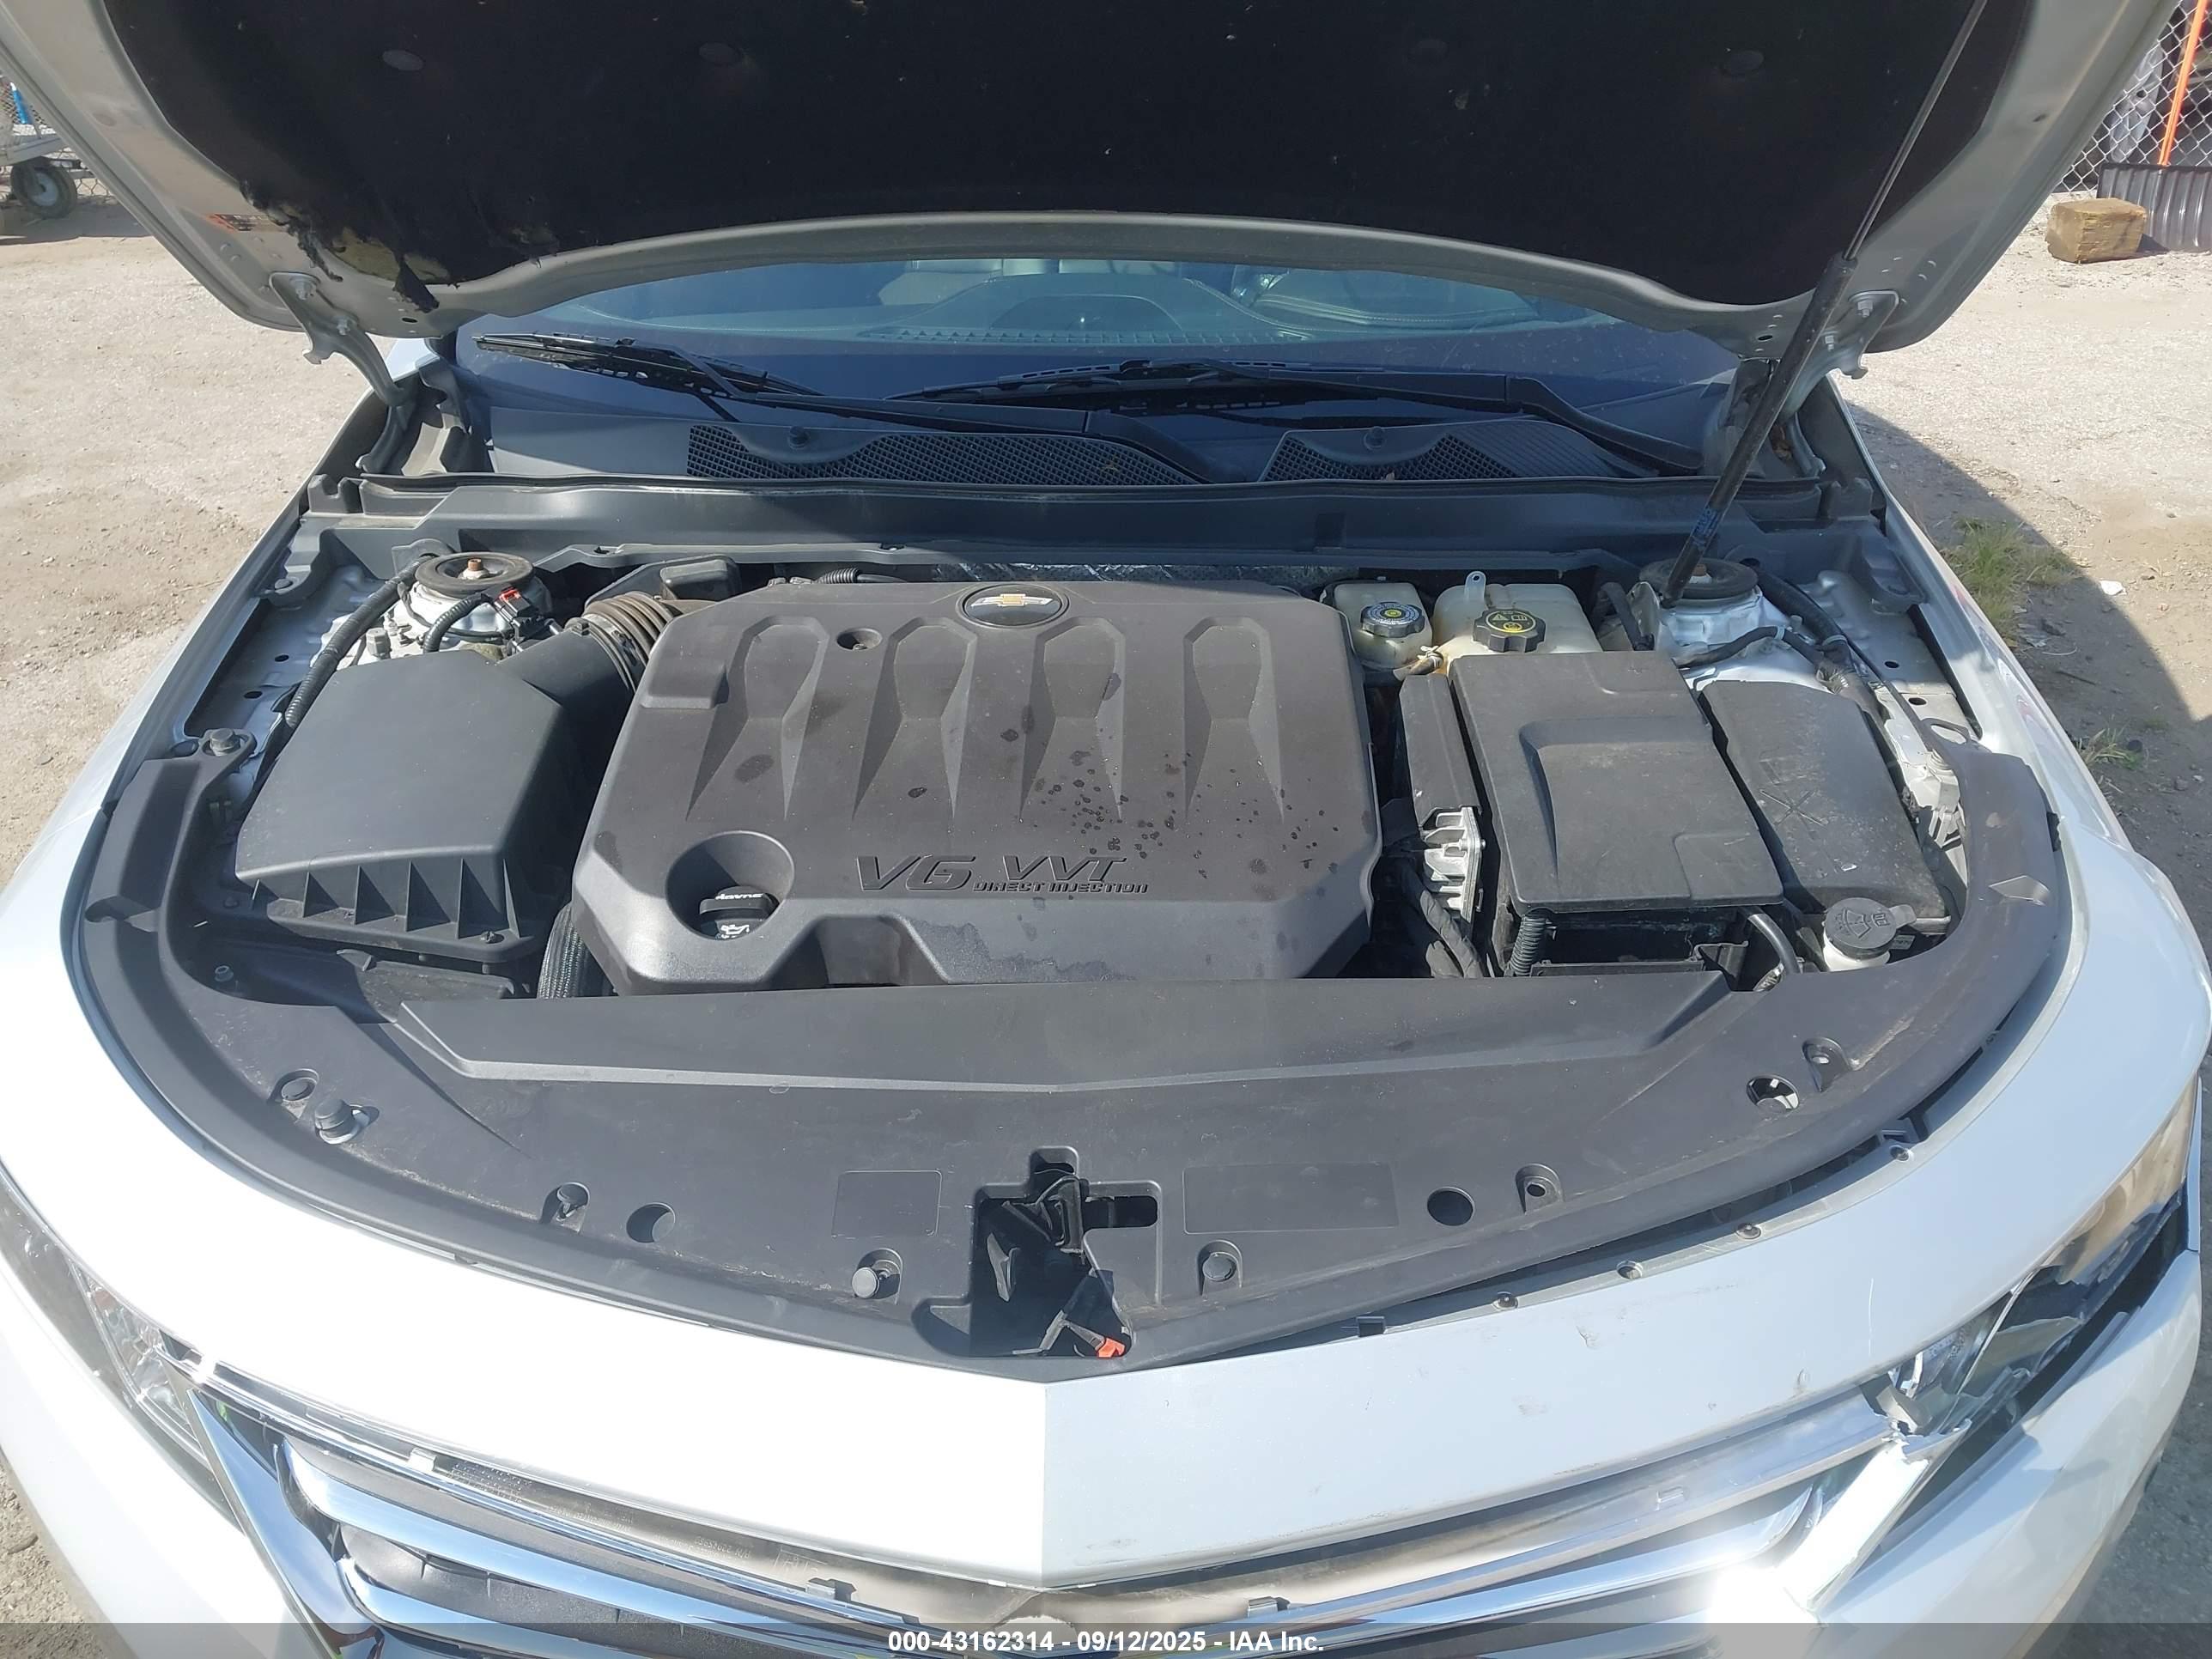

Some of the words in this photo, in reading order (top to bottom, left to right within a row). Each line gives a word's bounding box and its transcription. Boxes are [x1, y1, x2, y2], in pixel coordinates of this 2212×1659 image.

[856, 854, 975, 891] V6
[1003, 855, 1127, 882] VVT
[973, 881, 1045, 892] DIRECT
[1048, 883, 1149, 893] INJECTION
